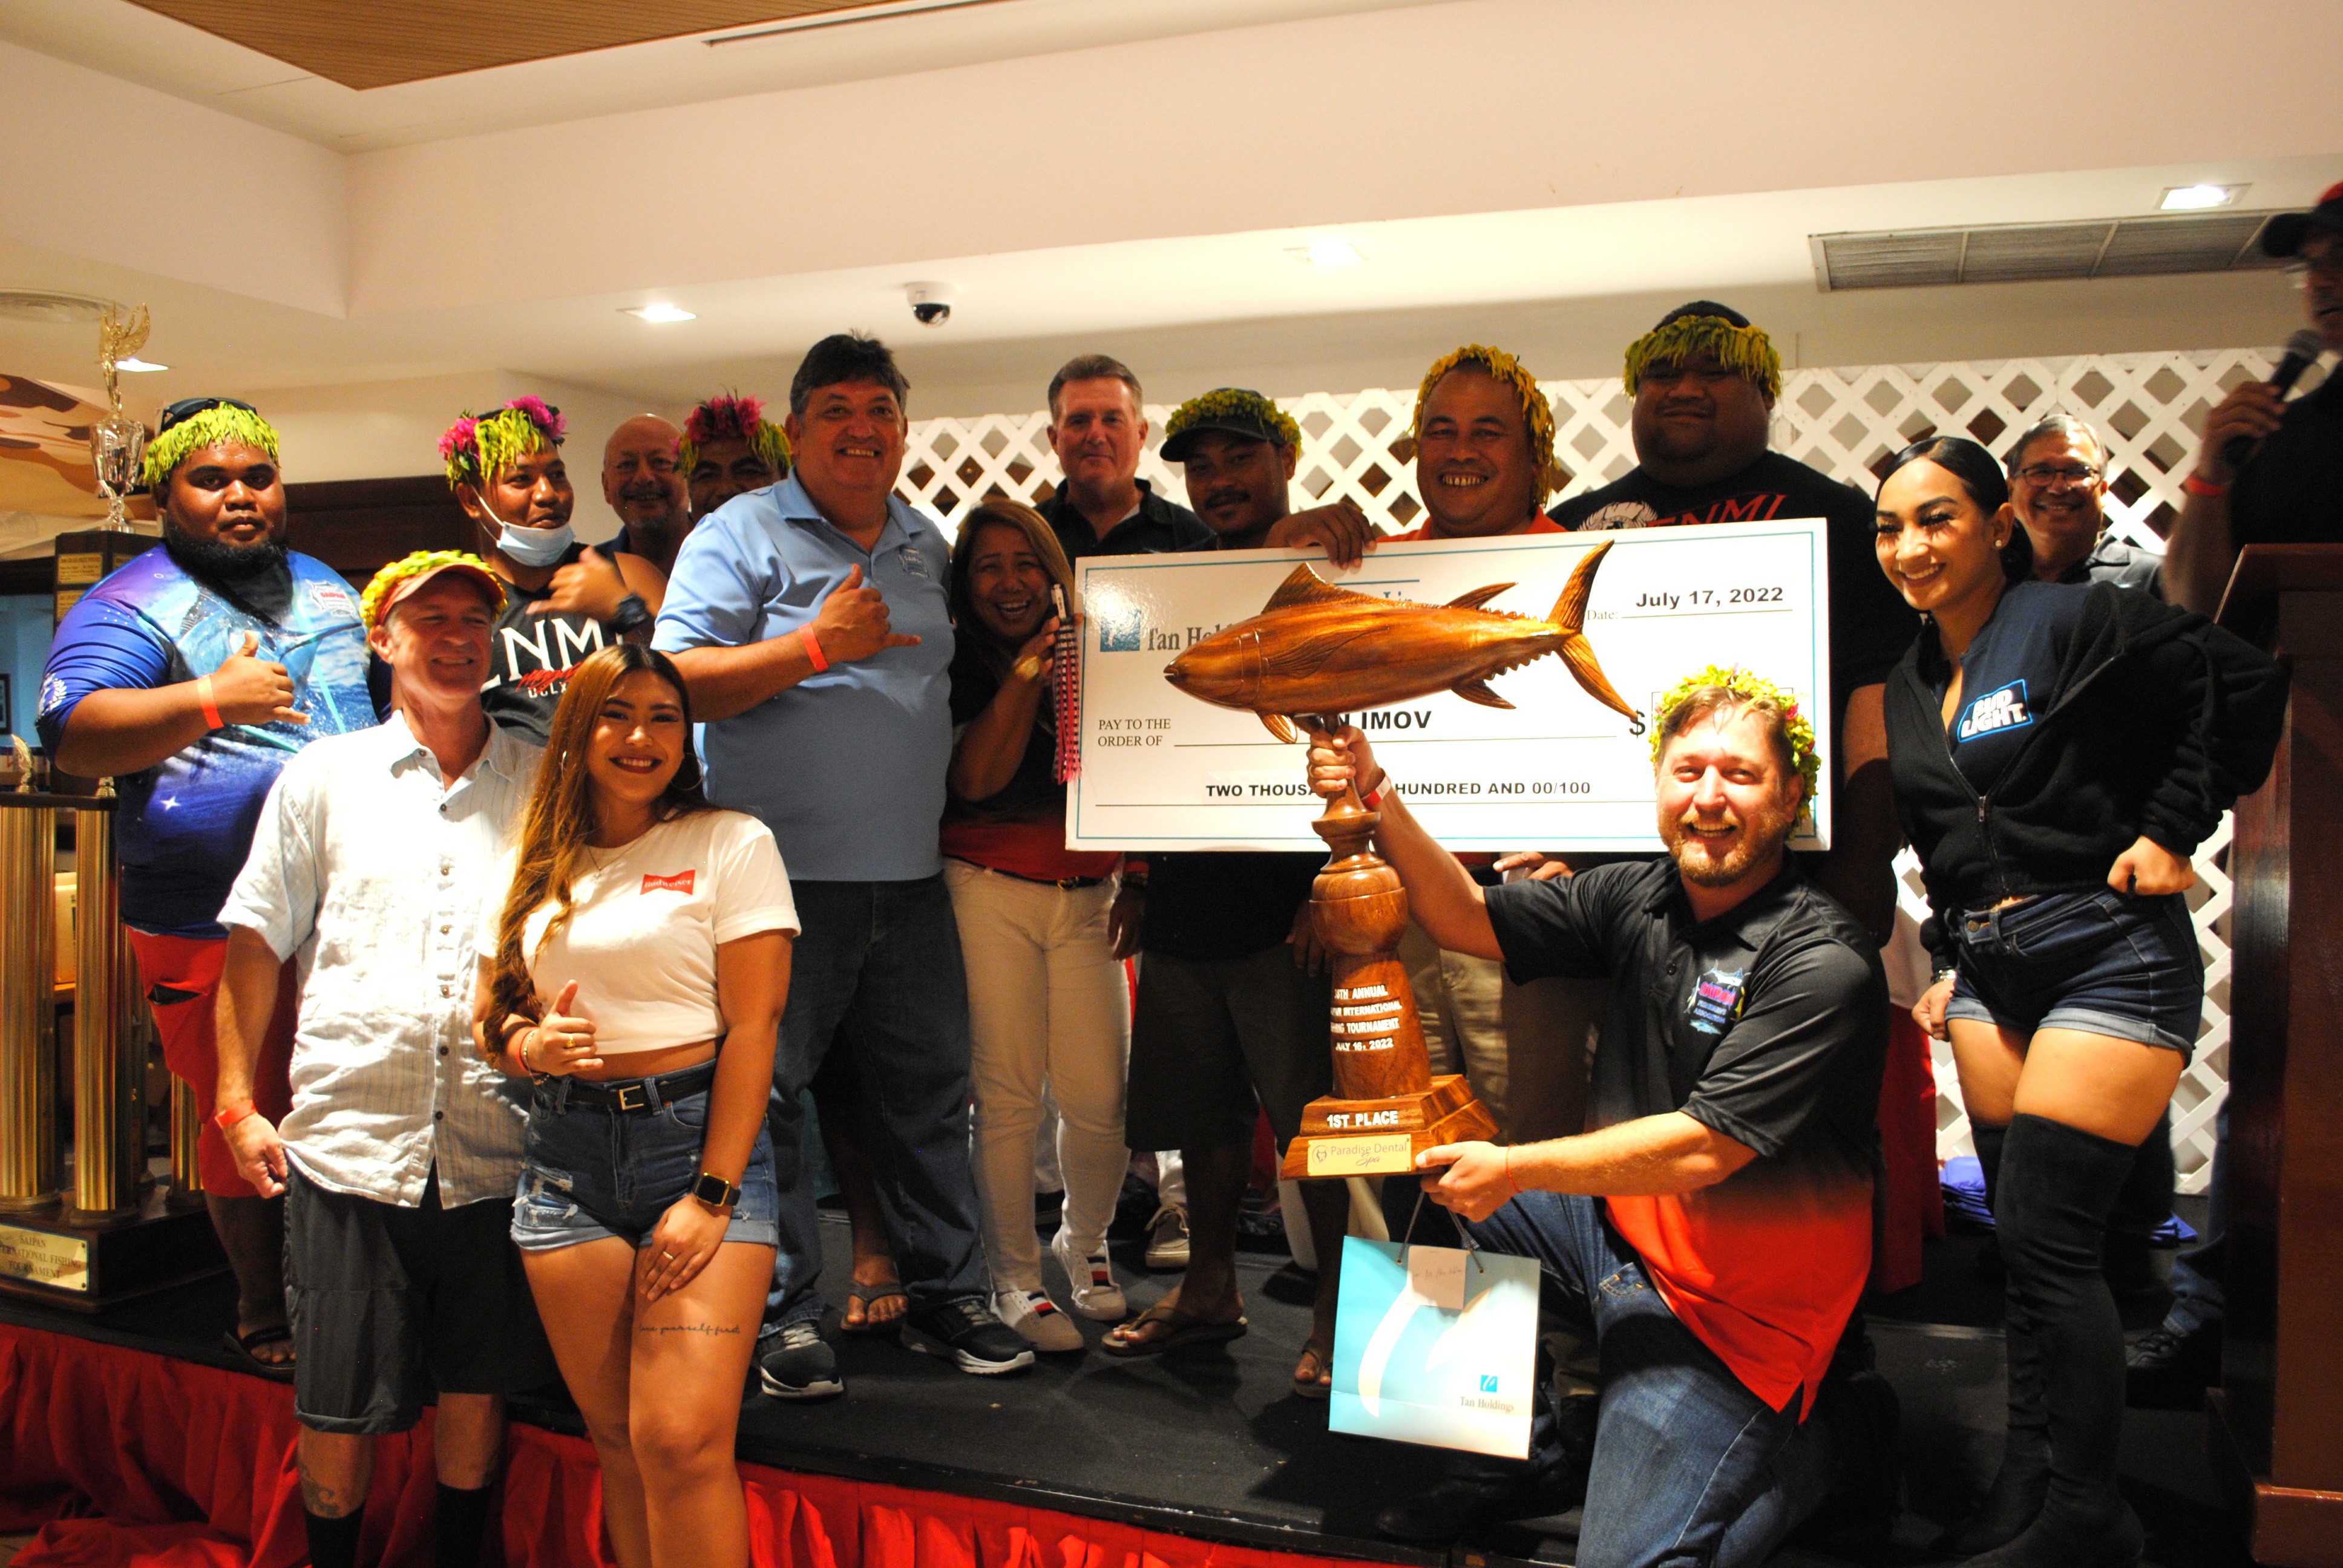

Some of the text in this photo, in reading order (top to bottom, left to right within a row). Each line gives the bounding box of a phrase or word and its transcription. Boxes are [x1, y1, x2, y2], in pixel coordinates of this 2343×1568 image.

[1636, 587, 1784, 610] July 17, 2022
[1587, 610, 1618, 621] Date:
[1147, 627, 1180, 651] Tan
[1973, 689, 2013, 718] BUD
[1099, 718, 1172, 730] PAY TO THE
[1362, 710, 1432, 730] IMOV
[1098, 735, 1163, 747] ORDER OF
[1206, 782, 1590, 797] TWO THOUS HUNDRED AND 00/100
[1352, 985, 1388, 999] ANNUAL
[1343, 1001, 1402, 1016] INTERNATIONAL
[1346, 1018, 1400, 1033] TOURNAMENT
[1335, 1037, 1394, 1051] JULY 16, 2022
[1327, 1111, 1398, 1128] 1ST PLACE
[1331, 1142, 1407, 1155] Paradise Dental
[20, 1235, 47, 1248] SAIPAN
[50, 1255, 81, 1269] FISHING
[1460, 1396, 1514, 1414] Tan Holdings
